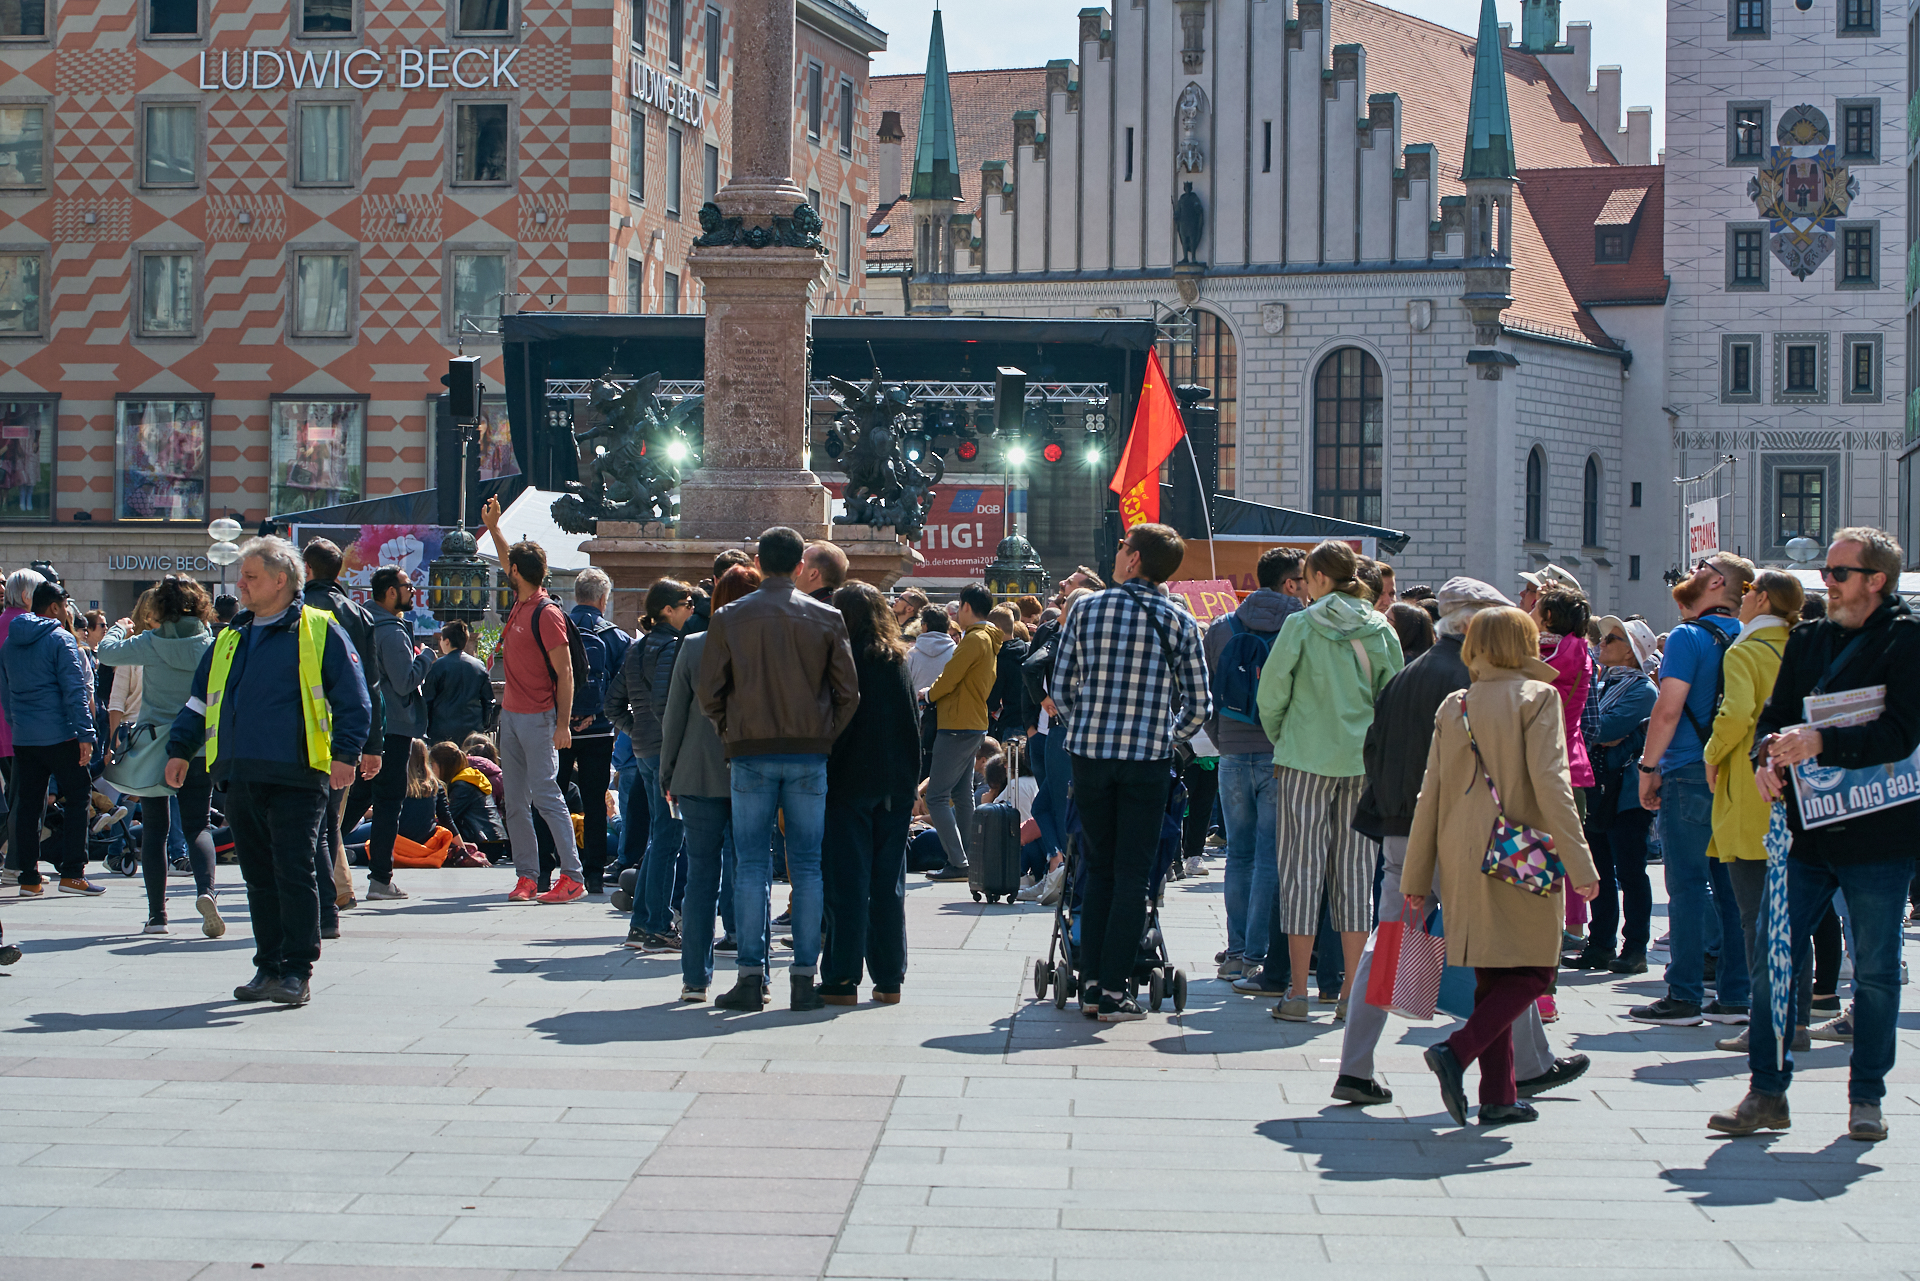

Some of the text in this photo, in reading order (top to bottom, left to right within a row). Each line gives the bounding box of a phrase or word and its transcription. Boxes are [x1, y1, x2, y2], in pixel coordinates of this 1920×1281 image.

[199, 48, 520, 90] LUDWIG BECK
[630, 57, 706, 131] LUDWIG BECK
[976, 504, 1001, 514] DGB
[1690, 516, 1717, 553] GETRÄNKE
[108, 555, 217, 571] LUDWIG BECK
[1805, 771, 1920, 820] Free City Tour
